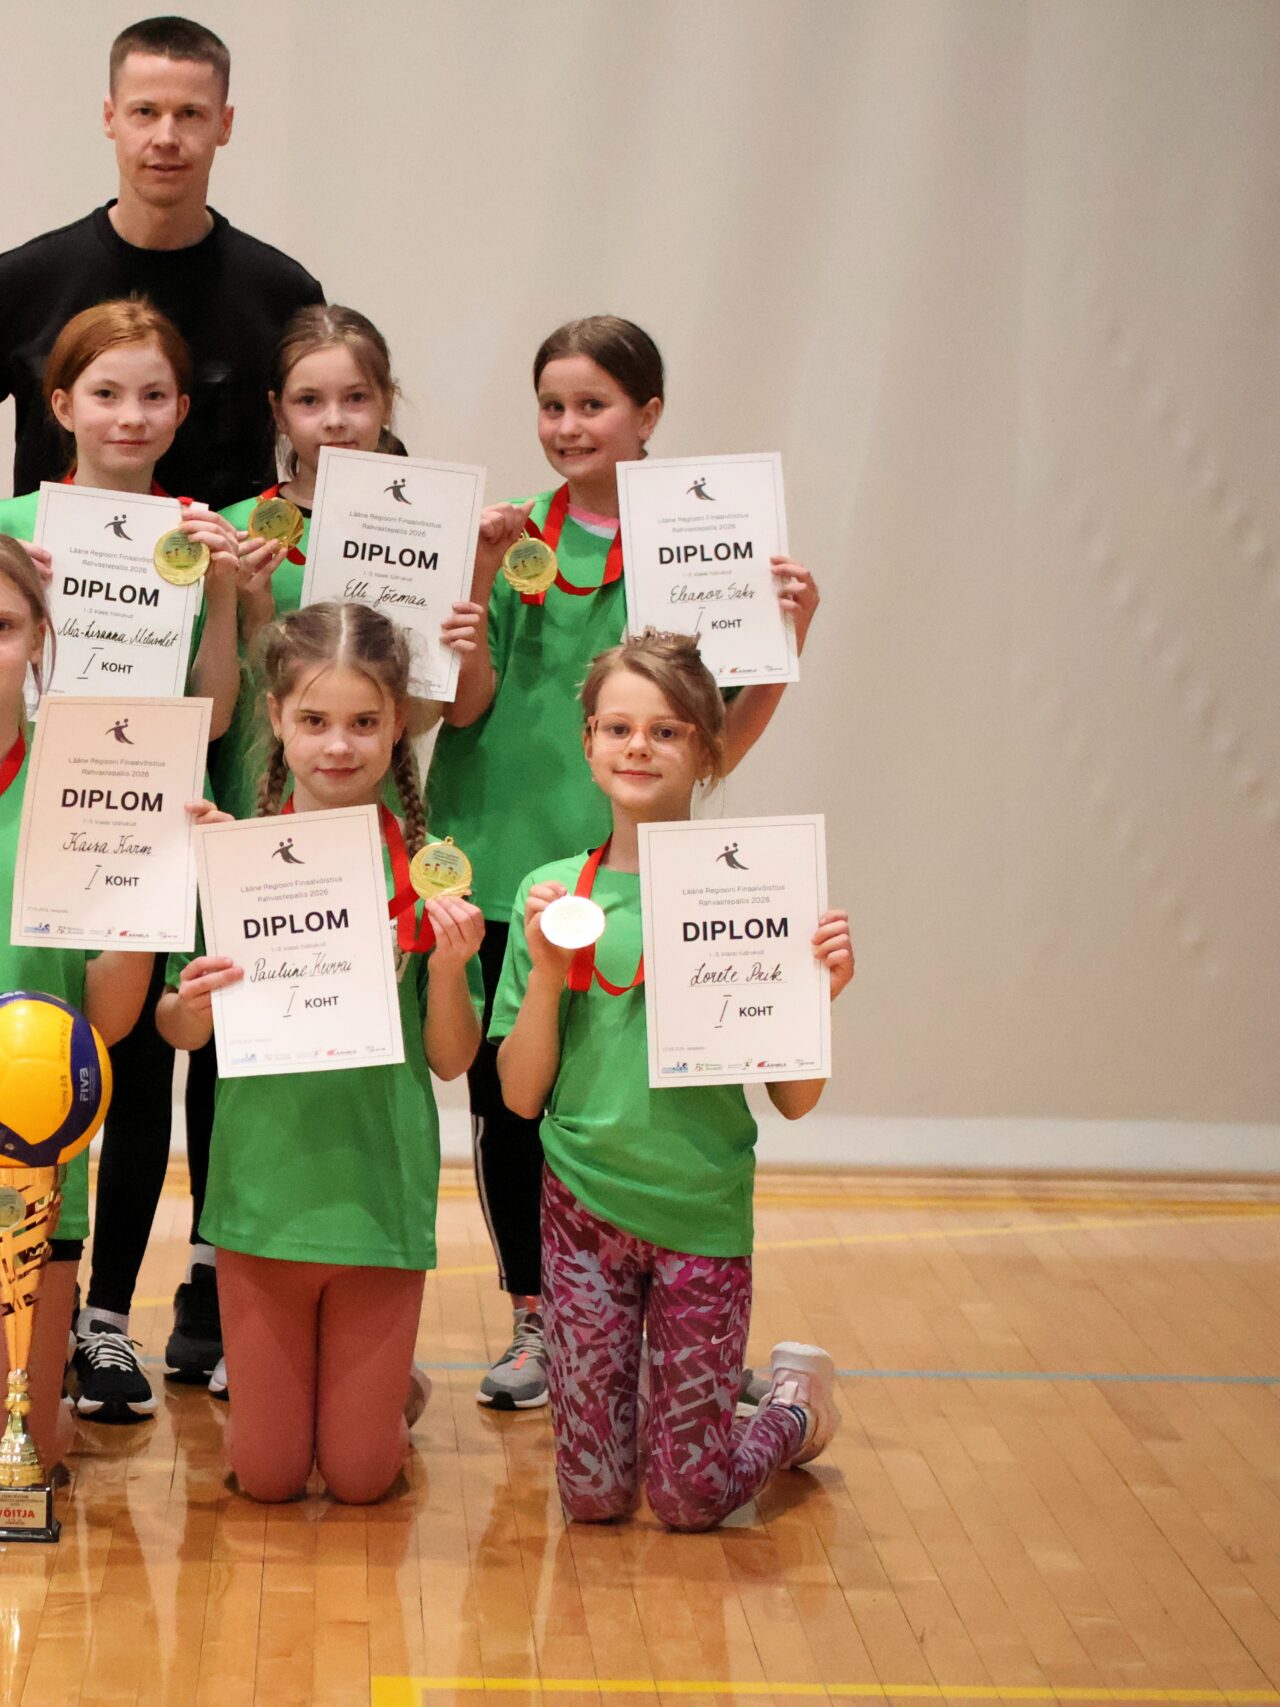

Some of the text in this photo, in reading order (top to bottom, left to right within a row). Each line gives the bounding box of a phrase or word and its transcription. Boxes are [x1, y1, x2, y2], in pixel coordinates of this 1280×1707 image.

[342, 540, 439, 571] DIPLOM
[659, 541, 754, 565] DIPLOM
[62, 577, 160, 607] DIPLOM
[373, 584, 428, 609] Jõemaa
[670, 584, 724, 604] Eleanor
[711, 618, 742, 630] KOHT
[101, 661, 134, 674] KOHT
[61, 788, 164, 812] DIPLOM
[105, 875, 140, 887] KOHT
[243, 908, 349, 939] DIPLOM
[682, 917, 789, 942] DIPLOM
[304, 995, 339, 1009] KOHT
[739, 1005, 774, 1017] KOHT
